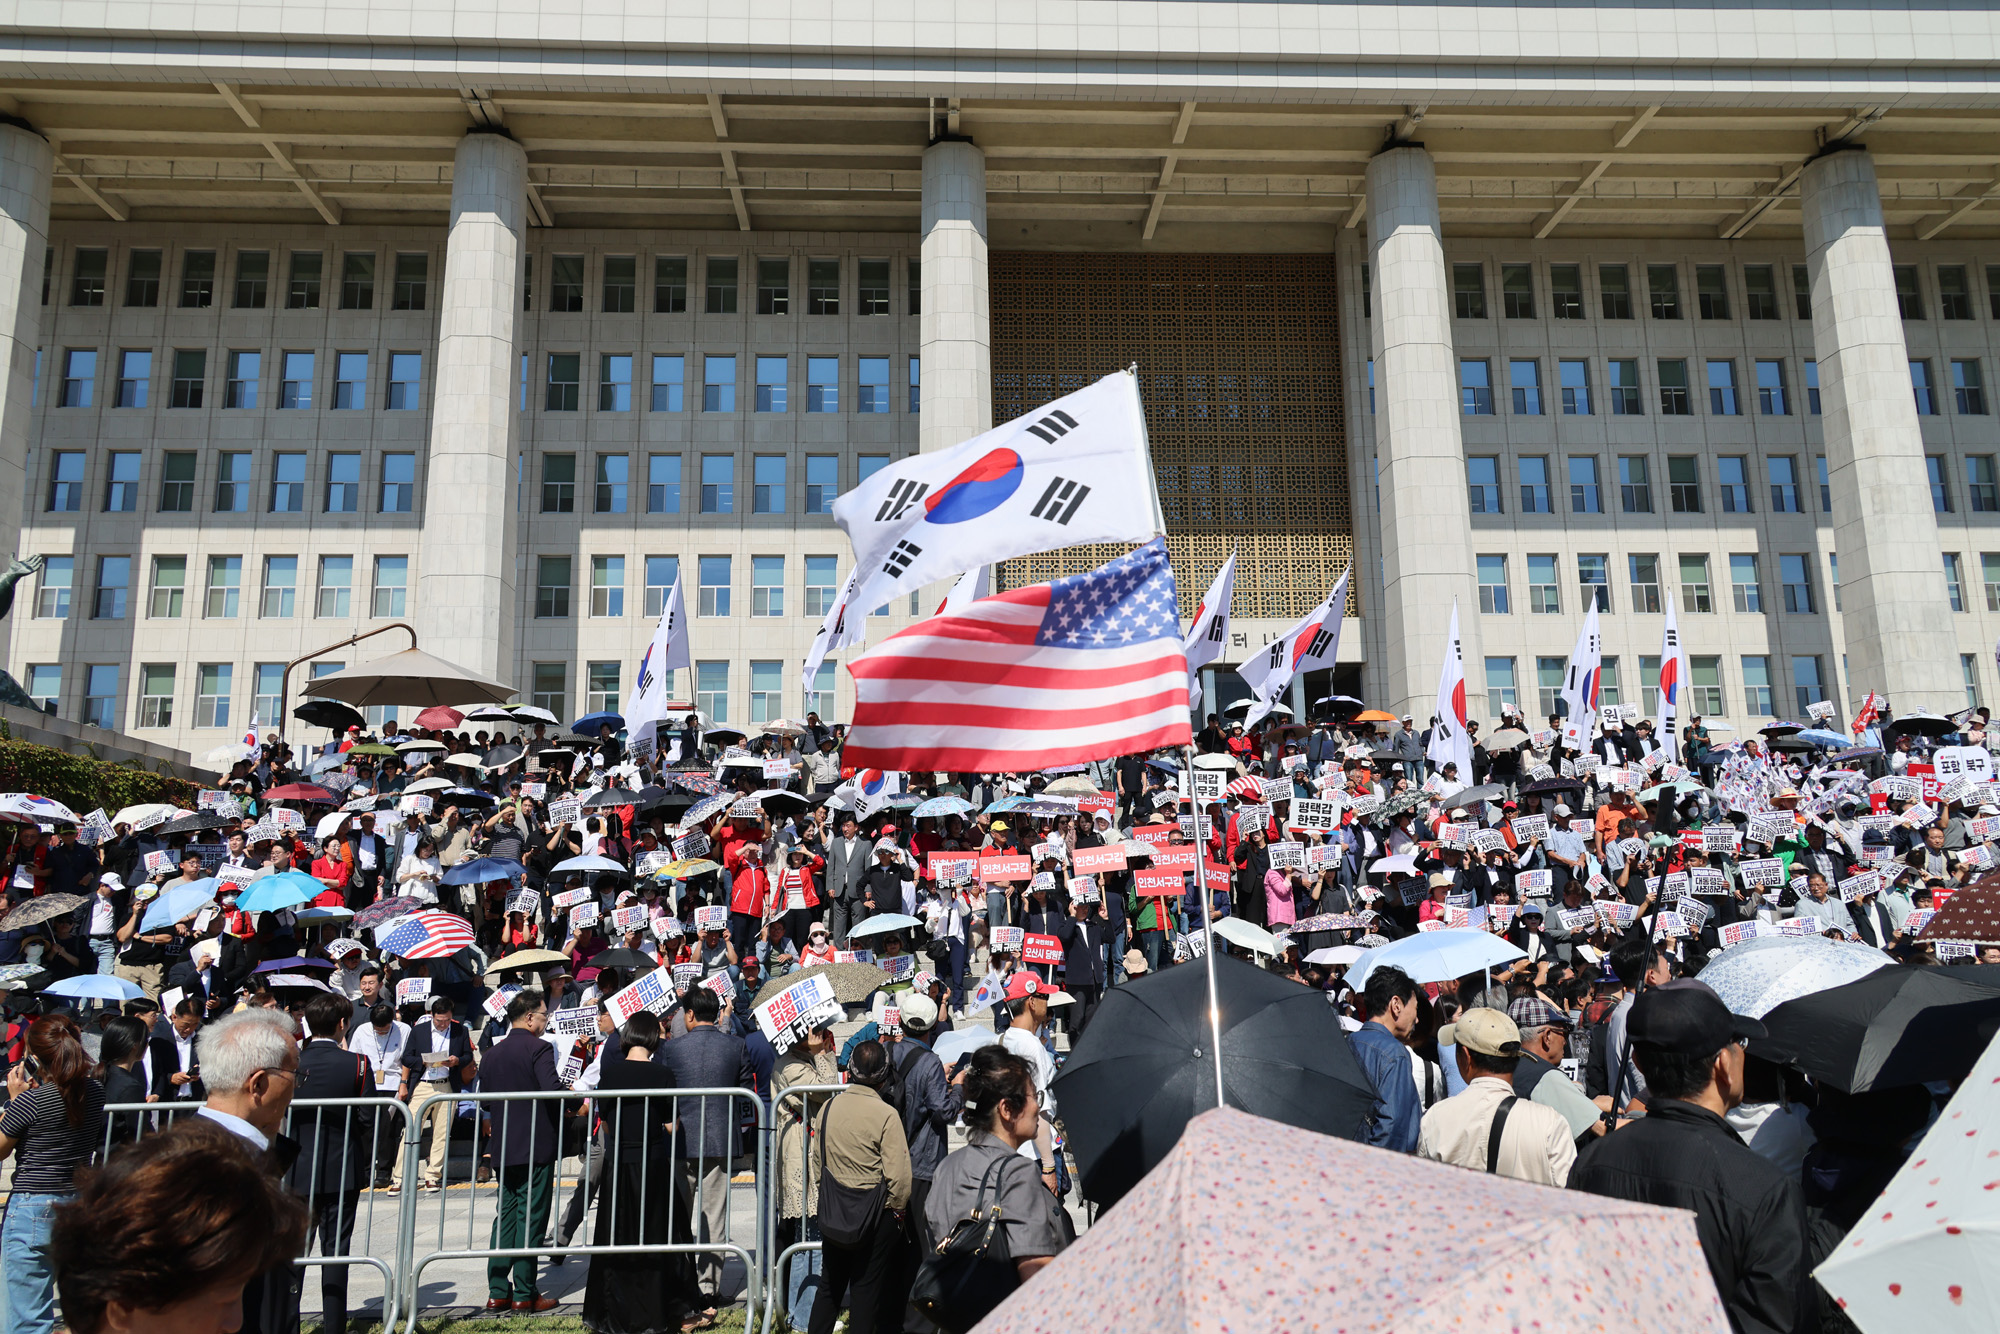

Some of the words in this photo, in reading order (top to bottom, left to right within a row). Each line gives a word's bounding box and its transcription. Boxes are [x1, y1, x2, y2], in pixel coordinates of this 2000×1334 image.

[1604, 708, 1618, 724] 원
[1941, 760, 1960, 773] 포항
[1966, 759, 1985, 771] 북구
[1298, 802, 1333, 815] 평택갑
[1181, 823, 1208, 831] 대통은
[1298, 815, 1331, 827] 한무경
[1517, 824, 1545, 835] 대통령은
[1706, 836, 1733, 844] 대통령은
[1075, 852, 1124, 867] 인천서구갑
[1272, 851, 1301, 859] 대통령은
[982, 862, 1029, 875] 인천서구갑
[1746, 868, 1780, 878] 대통령은
[1138, 875, 1182, 888] 인천서구갑
[1204, 869, 1229, 883] 천서구갑
[1696, 876, 1724, 885] 대통령은
[1843, 880, 1875, 894] 대통령은
[1725, 921, 1756, 935] 민생파탄
[1025, 947, 1044, 959] 오산시
[1940, 946, 1973, 956] 대통령은
[883, 956, 909, 967] 민생파탄
[617, 972, 657, 1009] 민생파탄
[767, 978, 816, 1016] 민생파탄
[648, 990, 677, 1017] 탄한다
[772, 990, 820, 1032] 헌정파괴
[559, 1017, 594, 1030] 대통령은
[884, 1016, 900, 1024] 헌정
[773, 1024, 798, 1055] 강력
